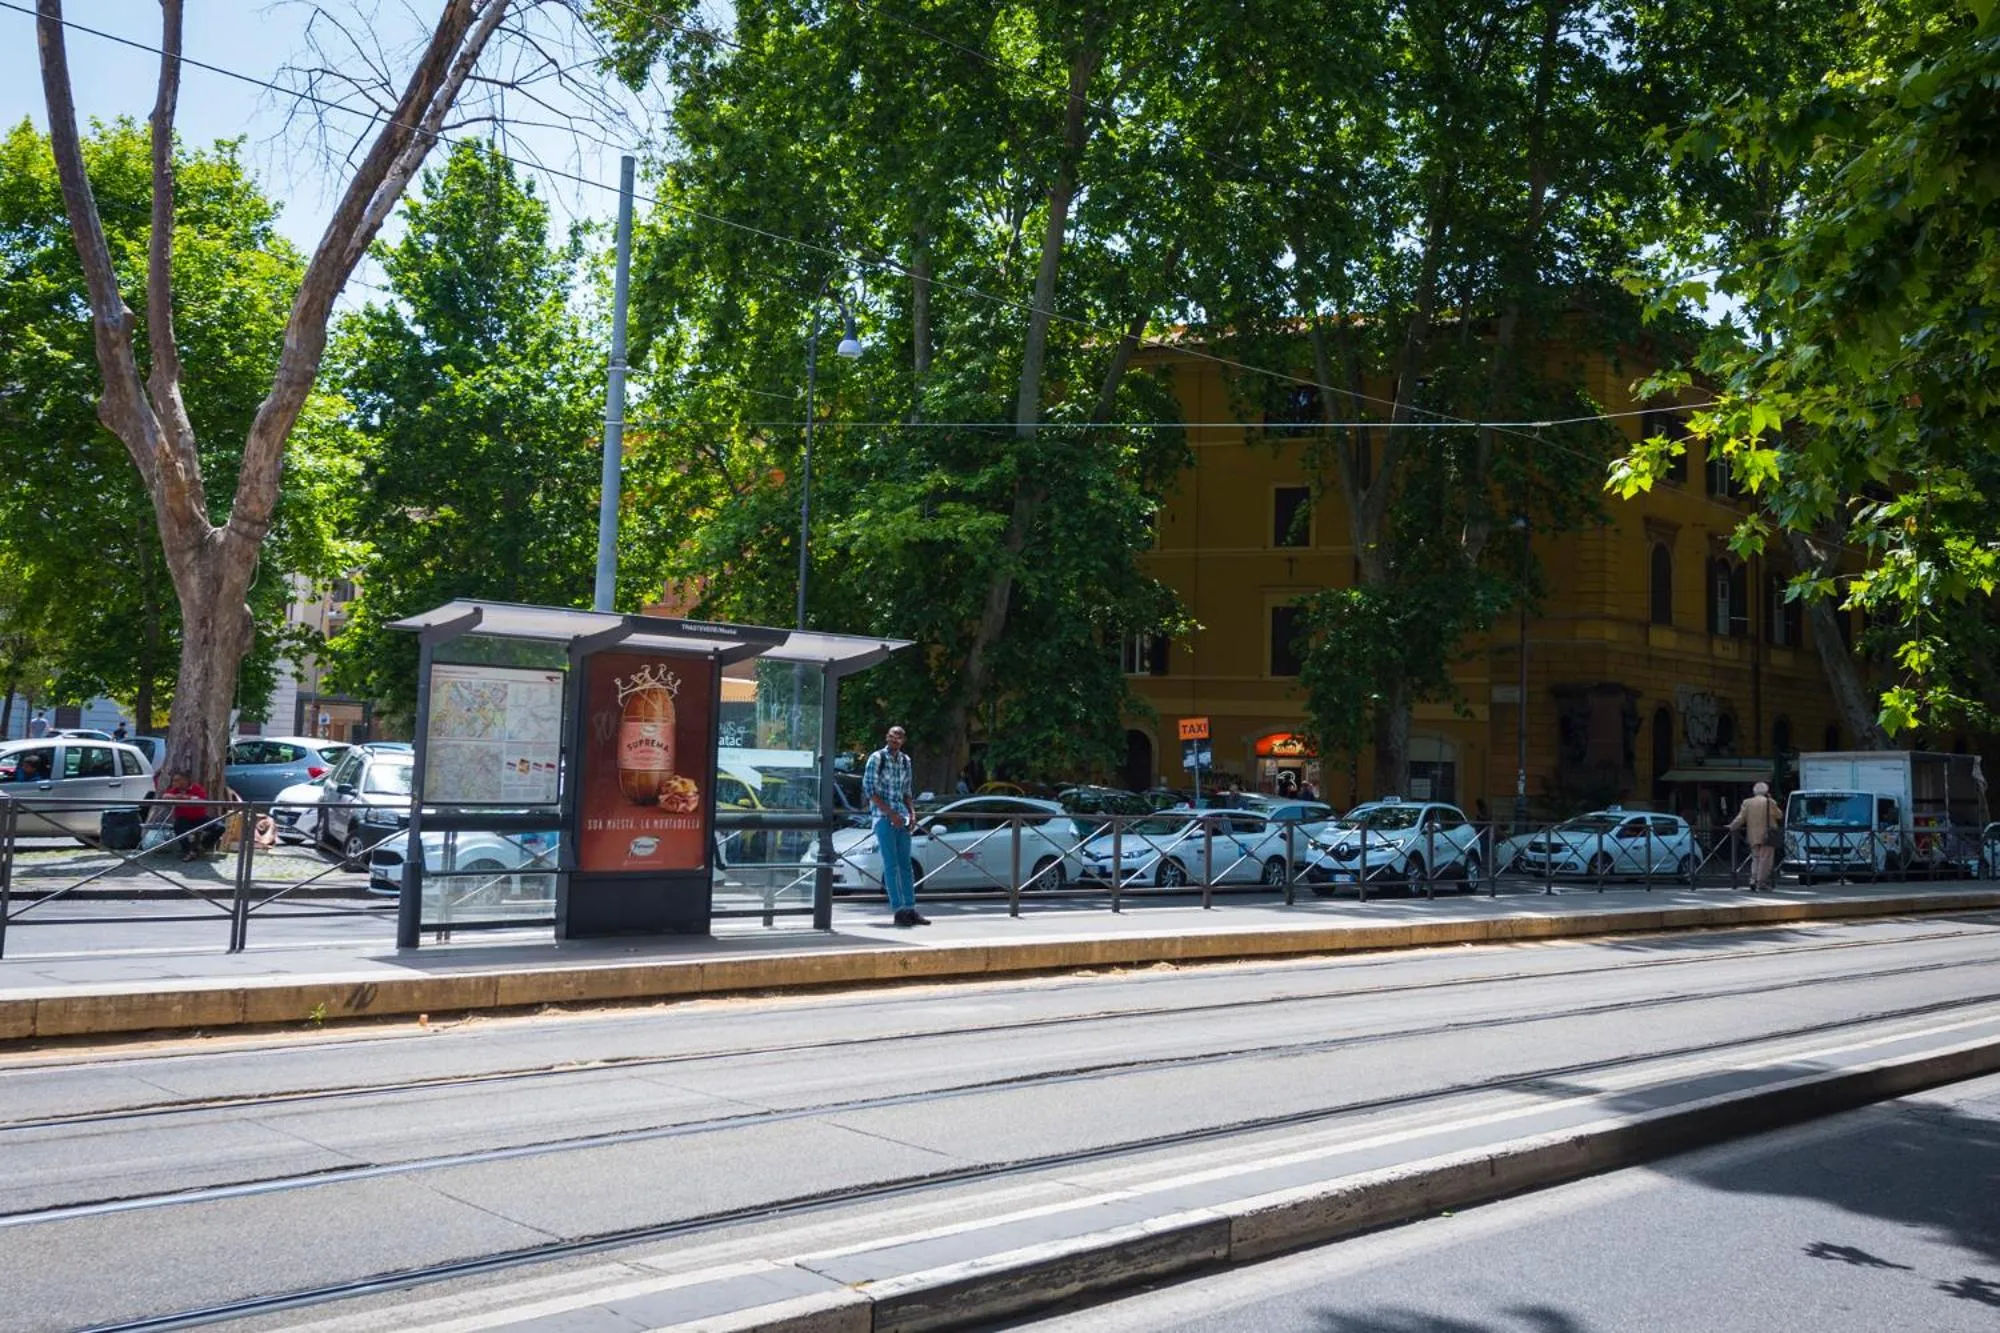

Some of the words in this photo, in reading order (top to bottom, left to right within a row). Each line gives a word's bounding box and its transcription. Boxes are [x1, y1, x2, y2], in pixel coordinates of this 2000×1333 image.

[1181, 724, 1207, 734] TAXI
[626, 738, 670, 752] SUPREMA
[718, 735, 742, 746] atac
[587, 818, 603, 830] SUA
[640, 818, 651, 830] LA
[653, 817, 700, 830] MORTADELLA
